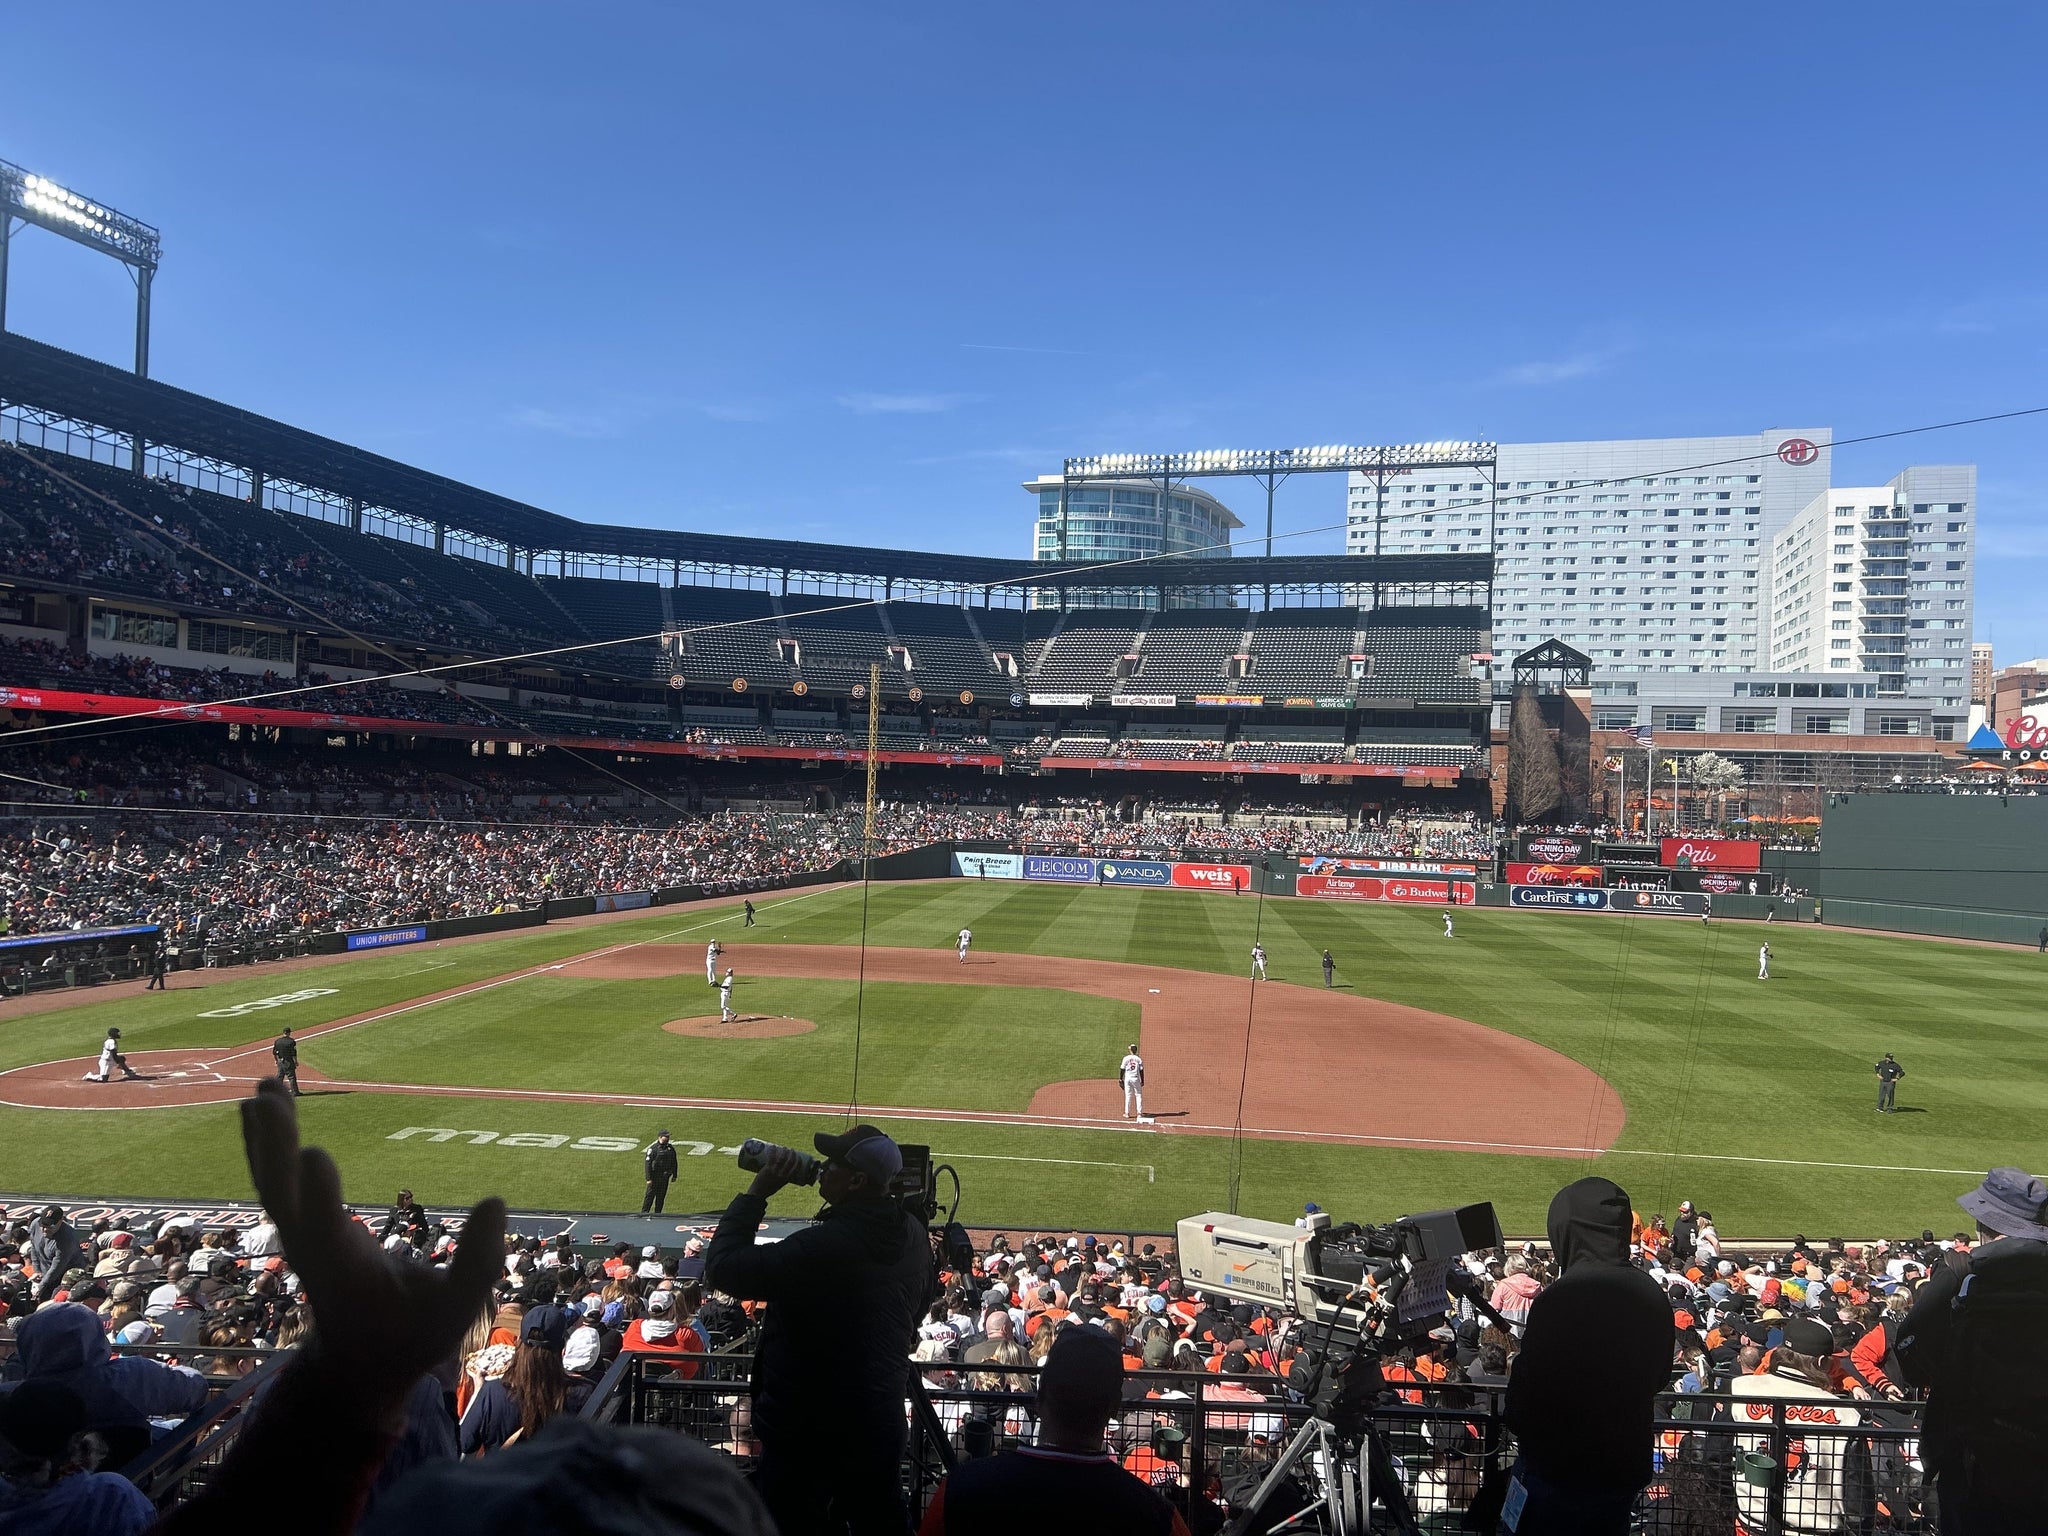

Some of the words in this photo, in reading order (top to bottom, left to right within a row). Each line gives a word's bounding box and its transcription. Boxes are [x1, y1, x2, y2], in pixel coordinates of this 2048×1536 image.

[672, 677, 684, 687] 20
[737, 681, 743, 689] 5
[853, 687, 864, 697] 22
[911, 690, 921, 699] 33
[21, 694, 41, 703] weis
[1011, 695, 1021, 704] 42
[1528, 844, 1564, 853] OPENING
[1564, 844, 1581, 854] DAY
[985, 857, 1011, 865] Breeze
[1029, 860, 1088, 874] LECOM
[1117, 866, 1164, 878] VANDA
[1379, 862, 1407, 871] BIRD
[1410, 863, 1441, 873] BATH
[1190, 867, 1233, 882] weis
[1326, 878, 1355, 888] Airtemp
[1700, 878, 1728, 886] OPENING
[1728, 879, 1742, 887] DAY
[1521, 890, 1573, 904] CareFirst
[1652, 894, 1683, 907] PNC
[356, 935, 377, 946] UNION
[378, 930, 417, 943] PIPEFITTERS
[1746, 1402, 1840, 1424] Oroles
